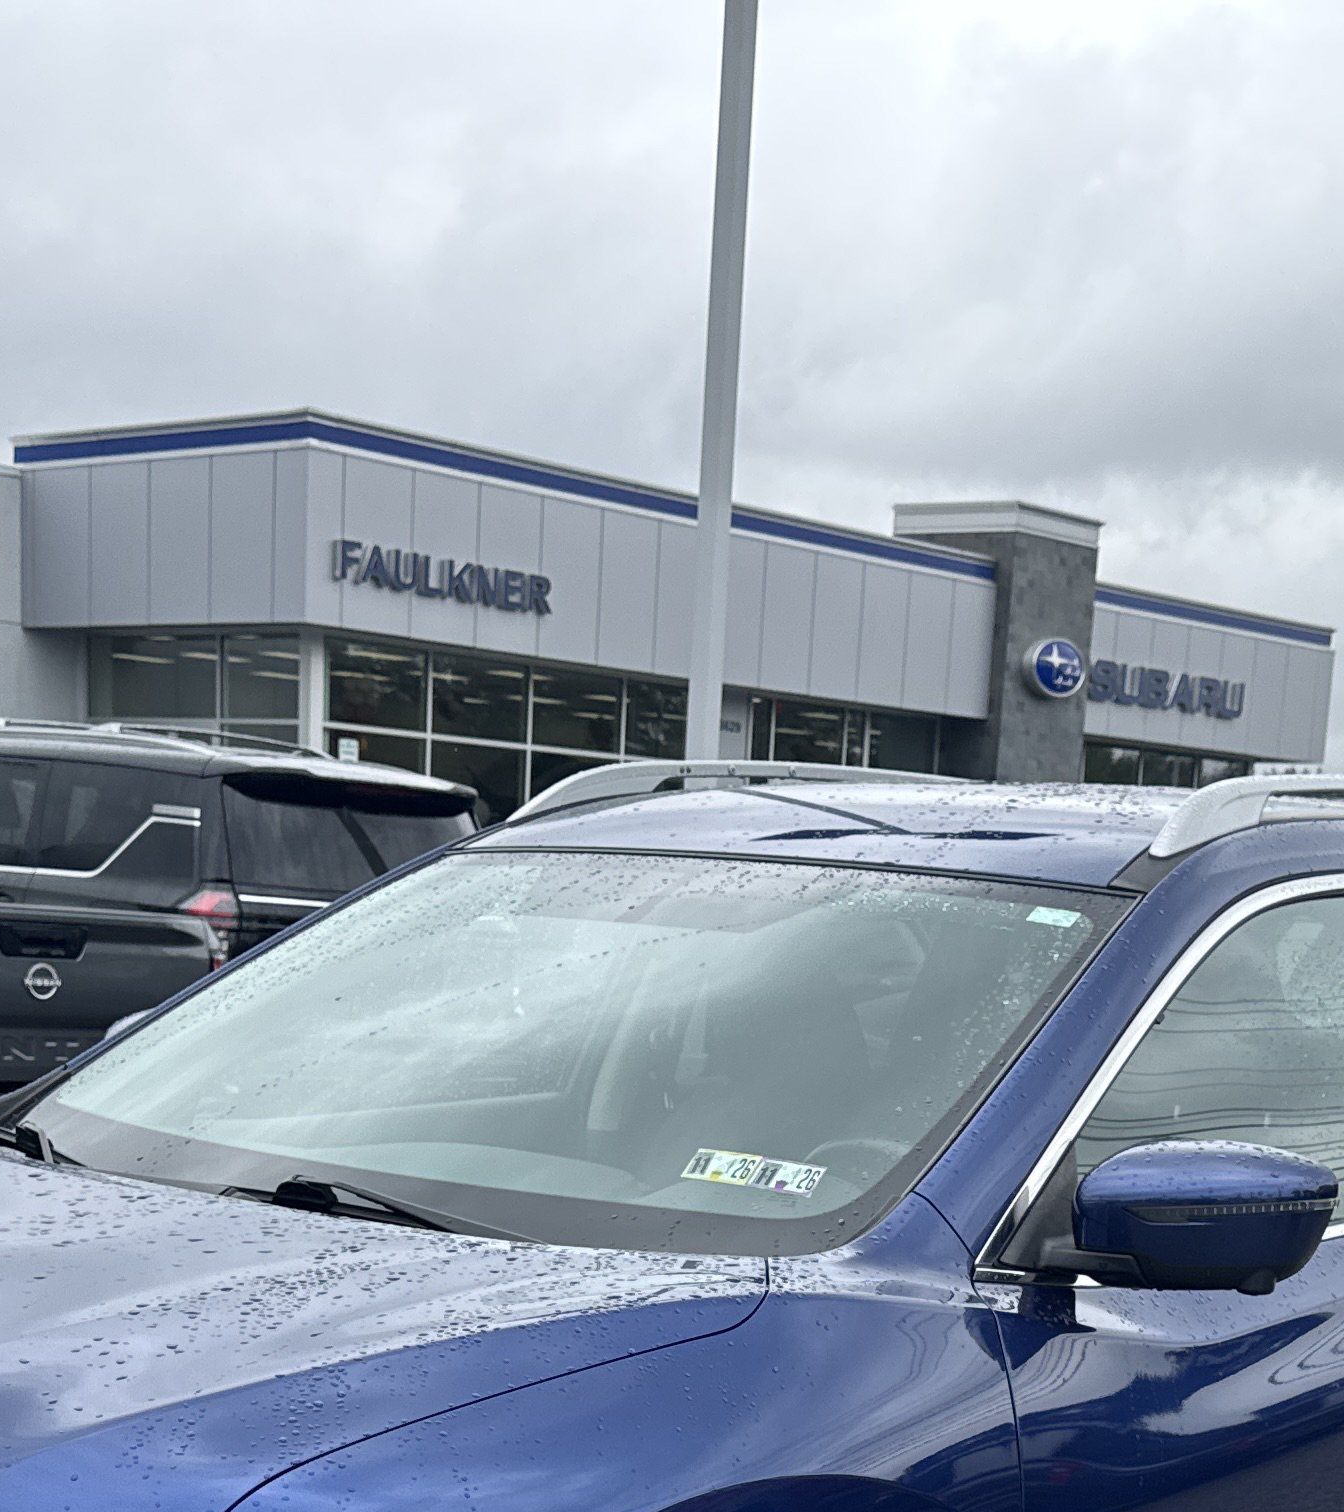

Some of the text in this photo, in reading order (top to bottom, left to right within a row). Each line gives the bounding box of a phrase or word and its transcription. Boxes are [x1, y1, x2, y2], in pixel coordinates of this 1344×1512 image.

[331, 538, 552, 616] FAULKNER
[1088, 659, 1247, 720] SUBARU
[690, 1156, 756, 1180] 11 26
[755, 1166, 821, 1191] 11 26
